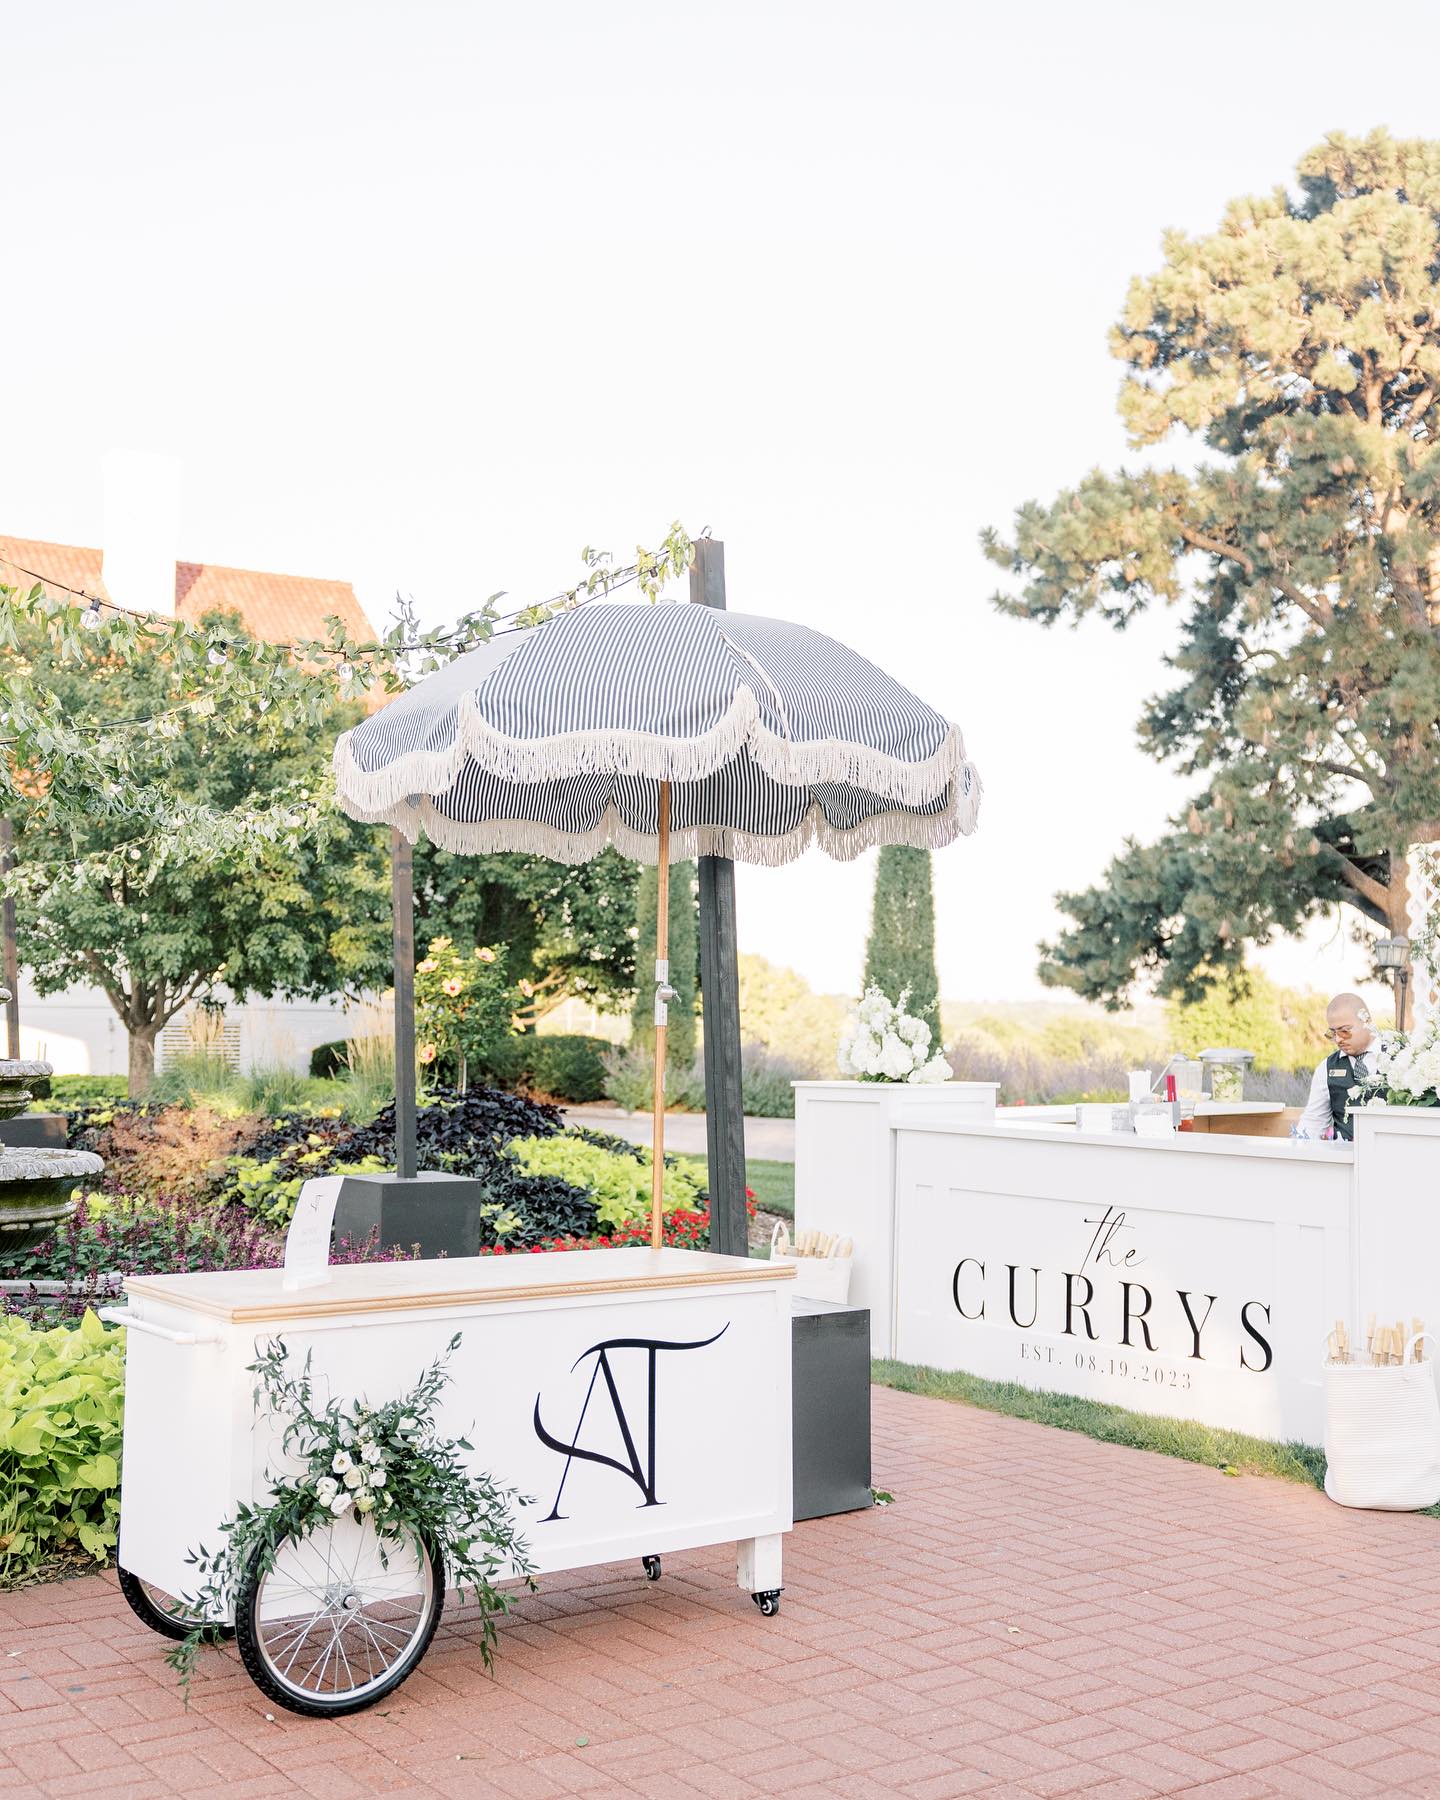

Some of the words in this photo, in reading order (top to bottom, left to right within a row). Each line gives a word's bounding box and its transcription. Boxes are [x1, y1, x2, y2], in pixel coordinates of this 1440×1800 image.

[1078, 1206, 1146, 1286] the
[952, 1258, 1274, 1373] CURRYS
[1020, 1342, 1063, 1366] EST.
[1074, 1351, 1192, 1391] 08.19.2023
